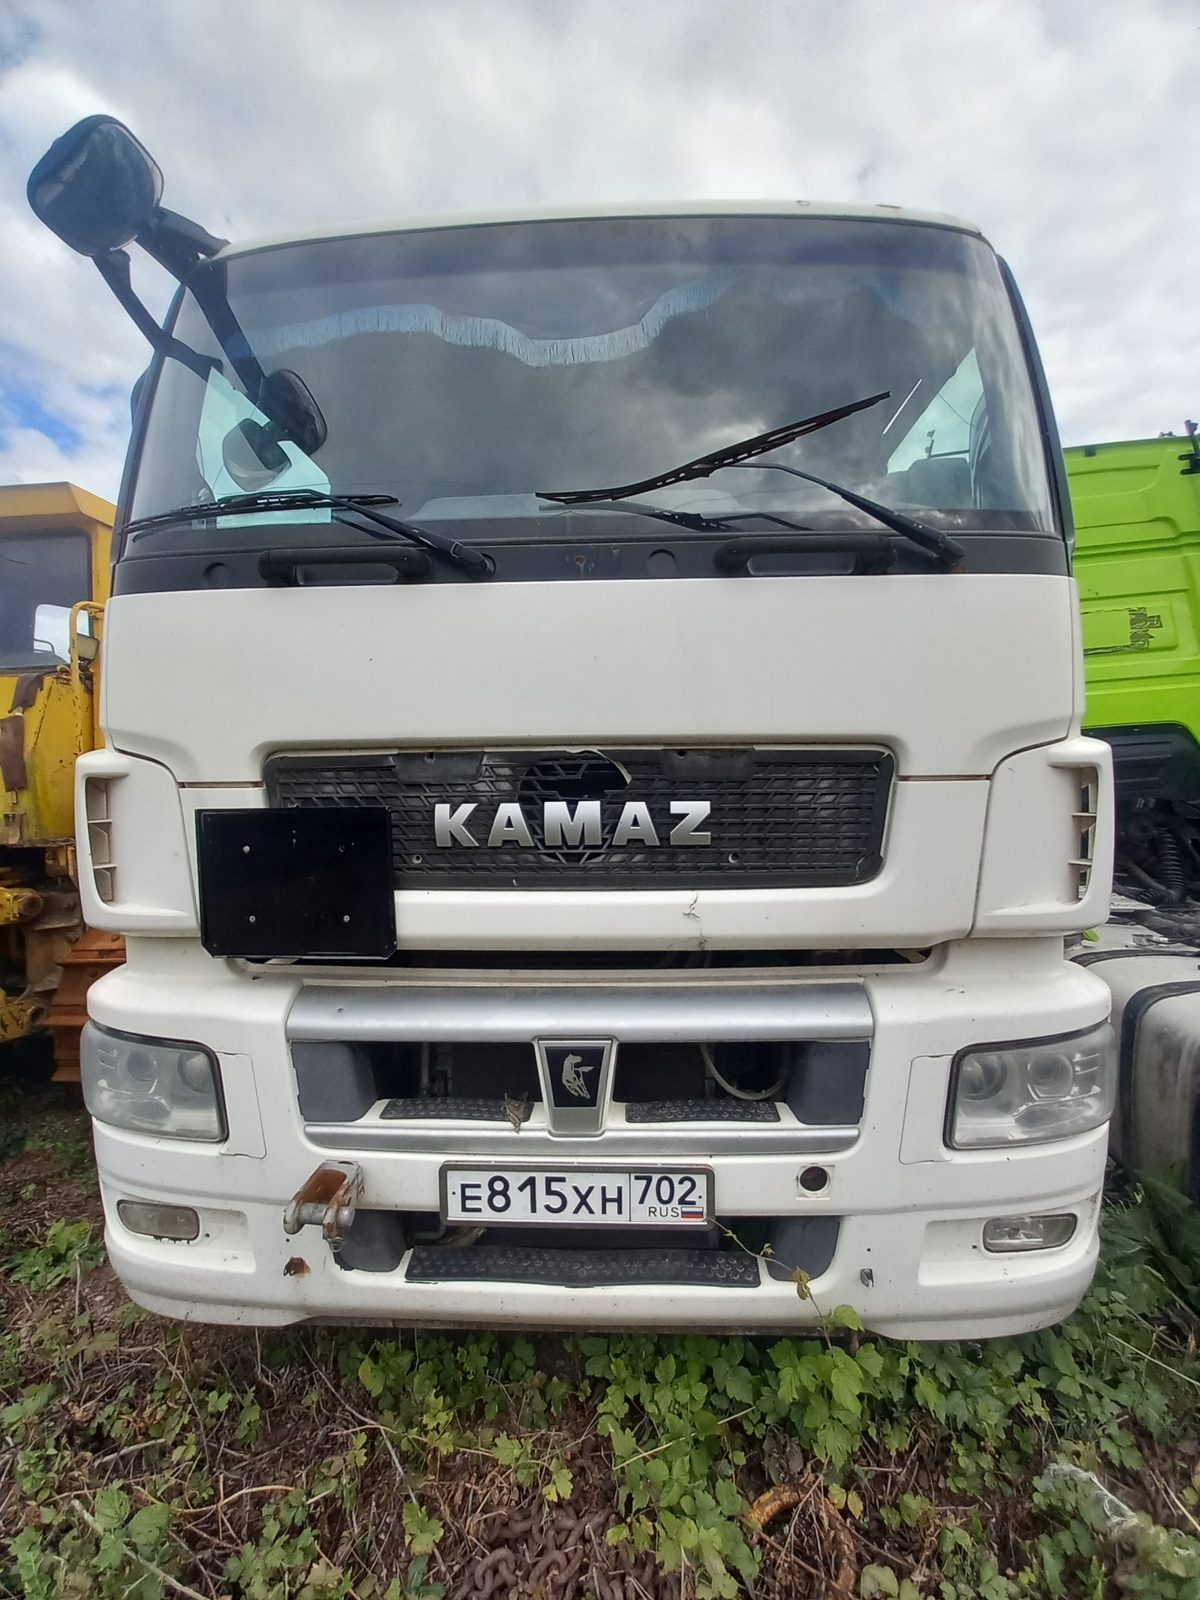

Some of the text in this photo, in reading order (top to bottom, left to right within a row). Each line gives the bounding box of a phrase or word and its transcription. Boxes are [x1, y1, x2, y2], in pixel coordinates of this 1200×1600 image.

[434, 800, 711, 847] KAMAZ
[634, 1175, 697, 1206] 702
[648, 1206, 680, 1218] RUS
